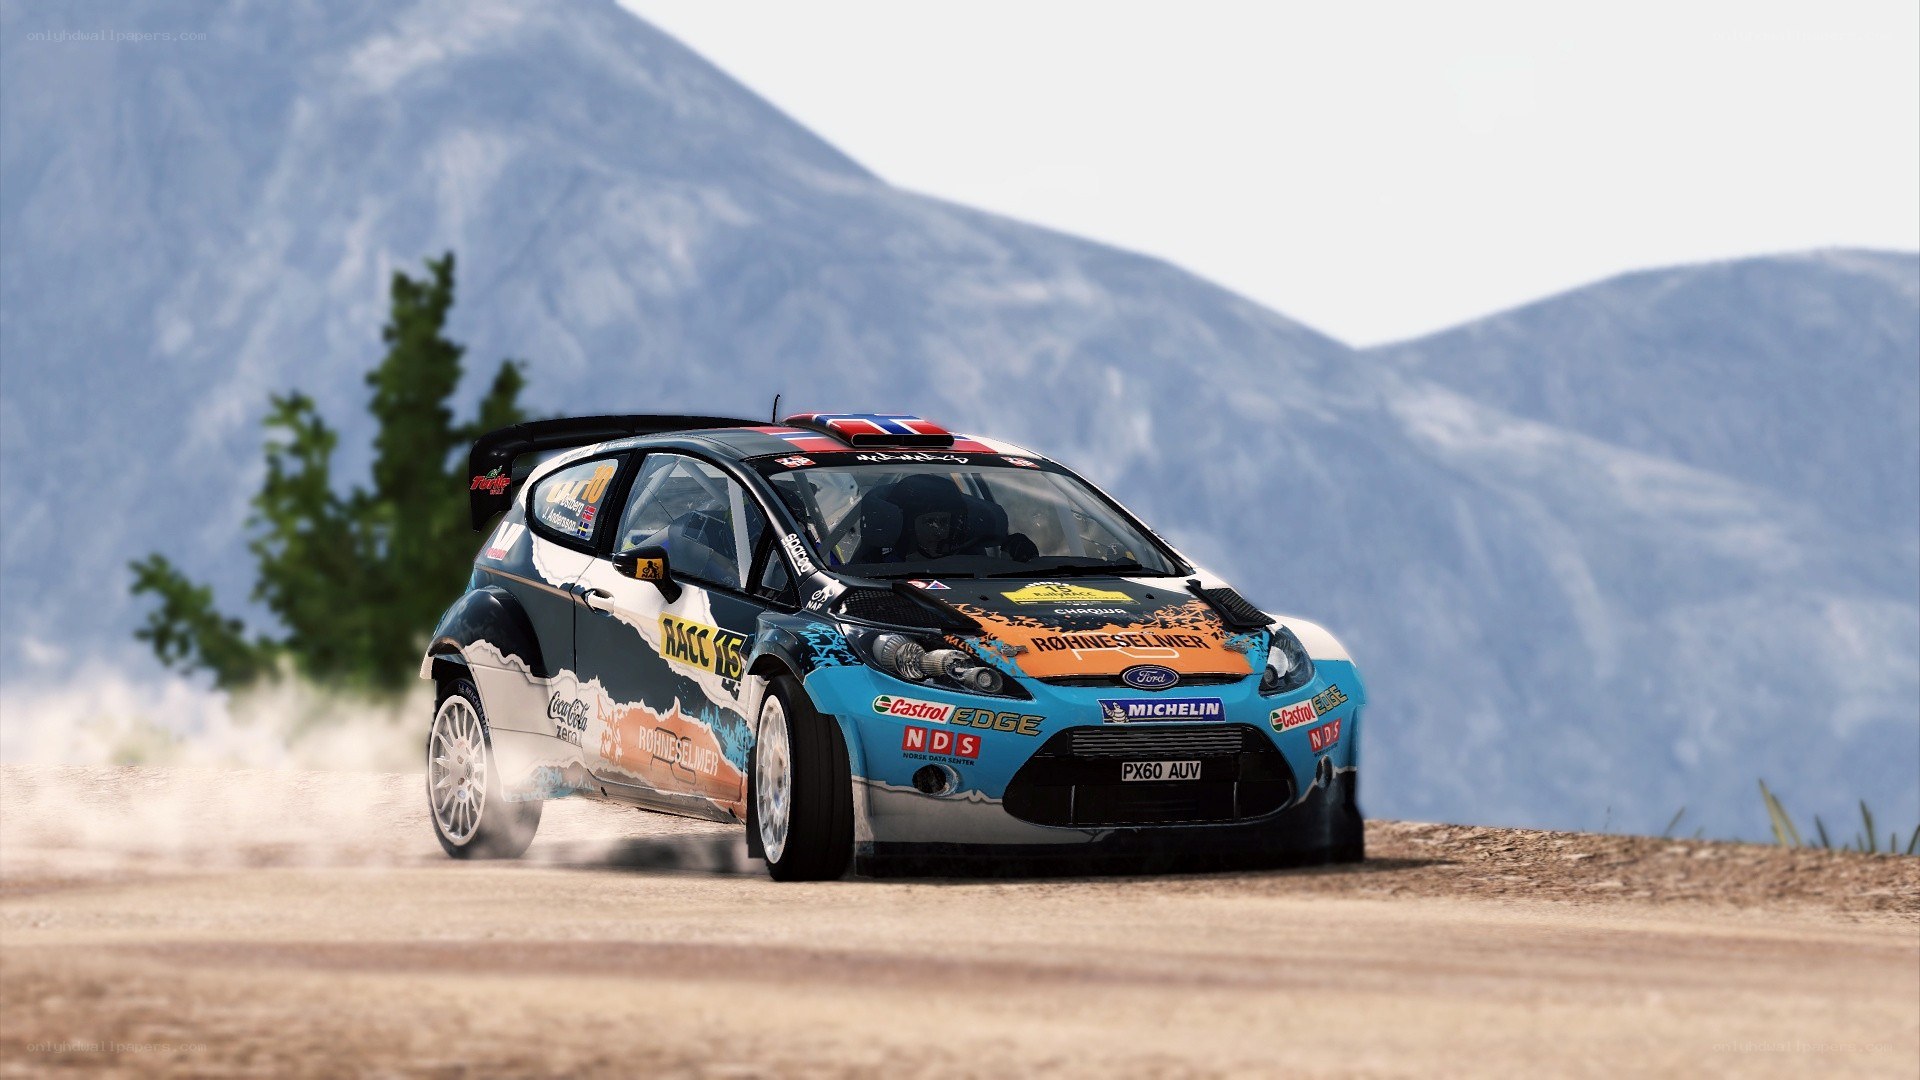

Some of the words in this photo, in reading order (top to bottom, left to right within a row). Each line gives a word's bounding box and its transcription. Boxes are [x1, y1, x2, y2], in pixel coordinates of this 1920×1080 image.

[784, 533, 812, 574] sparco
[663, 618, 710, 667] RACC
[714, 631, 743, 678] 15
[1031, 632, 1211, 653] RØHNESELMER
[1136, 670, 1167, 684] Ford
[1128, 702, 1220, 717] MICHELIN
[1281, 702, 1316, 728] Castrol
[1311, 684, 1349, 717] EDGE
[890, 698, 949, 722] Castrol
[950, 707, 1047, 737] EDGE
[556, 725, 578, 744] zero
[638, 725, 719, 777] RØHNESELMER
[903, 752, 927, 761] NORSK
[928, 755, 947, 763] DATA
[948, 757, 976, 766] SENTER
[1123, 763, 1163, 779] PX60
[1168, 762, 1200, 778] AUV
